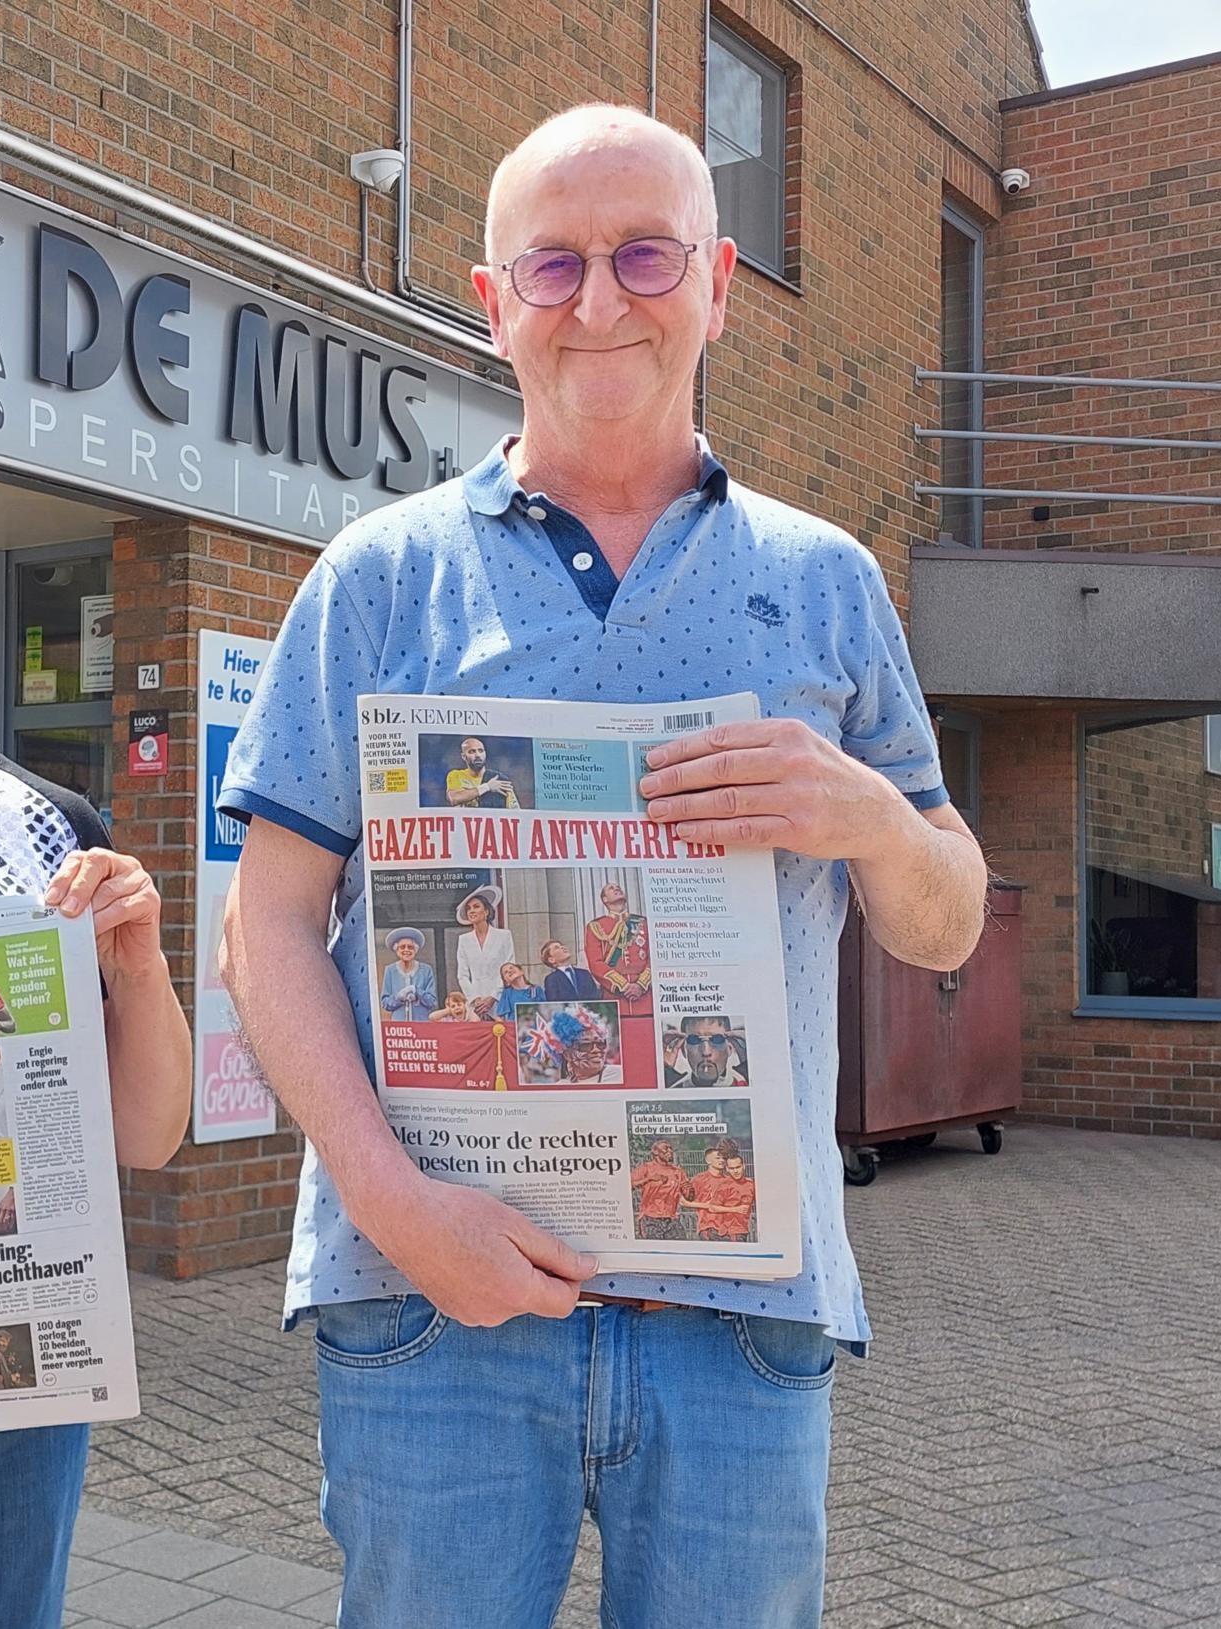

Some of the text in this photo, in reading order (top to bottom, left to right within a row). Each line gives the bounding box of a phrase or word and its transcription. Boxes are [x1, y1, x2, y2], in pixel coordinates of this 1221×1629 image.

[37, 221, 191, 426] DE
[30, 398, 201, 494] PERS
[223, 648, 260, 674] Hier
[141, 668, 156, 686] 74
[208, 679, 223, 700] te
[134, 716, 156, 727] LUCO
[361, 708, 489, 726] 8 blz. KEMPEN
[541, 753, 592, 761] Toptransfer
[565, 764, 605, 772] Westerlo:
[368, 817, 454, 861] GAZET
[463, 817, 520, 859] VAN
[44, 908, 56, 917] 25°
[7, 957, 26, 968] Wat
[9, 971, 20, 981] zo
[9, 981, 46, 994] zouden
[660, 984, 678, 993] Nog
[699, 984, 720, 992] keer
[11, 992, 51, 1009] spelen?
[660, 1004, 722, 1014] in Waagnatie
[385, 1027, 416, 1038] LOUIS,
[386, 1039, 438, 1049] CHARLOTTE
[28, 1046, 53, 1061] Engie
[387, 1051, 437, 1060] EN GEORGE
[16, 1056, 68, 1070] zet regering
[388, 1062, 465, 1073] STELEN DE SHOW
[24, 1069, 61, 1080] opnieuw
[20, 1077, 68, 1091] onder druk
[635, 1126, 657, 1134] derby
[675, 1125, 693, 1134] Lage
[428, 1130, 450, 1147] 29
[455, 1135, 501, 1149] voor
[507, 1131, 532, 1149] de
[538, 1130, 618, 1149] rechter
[418, 1155, 621, 1176] pesten in chatgroep
[37, 1319, 81, 1331] 100 dagen
[38, 1331, 66, 1341] oorlog
[39, 1339, 85, 1350] 10 beelden
[41, 1351, 54, 1360] die
[69, 1347, 91, 1357] nooit
[42, 1357, 103, 1370] meer vergeten
